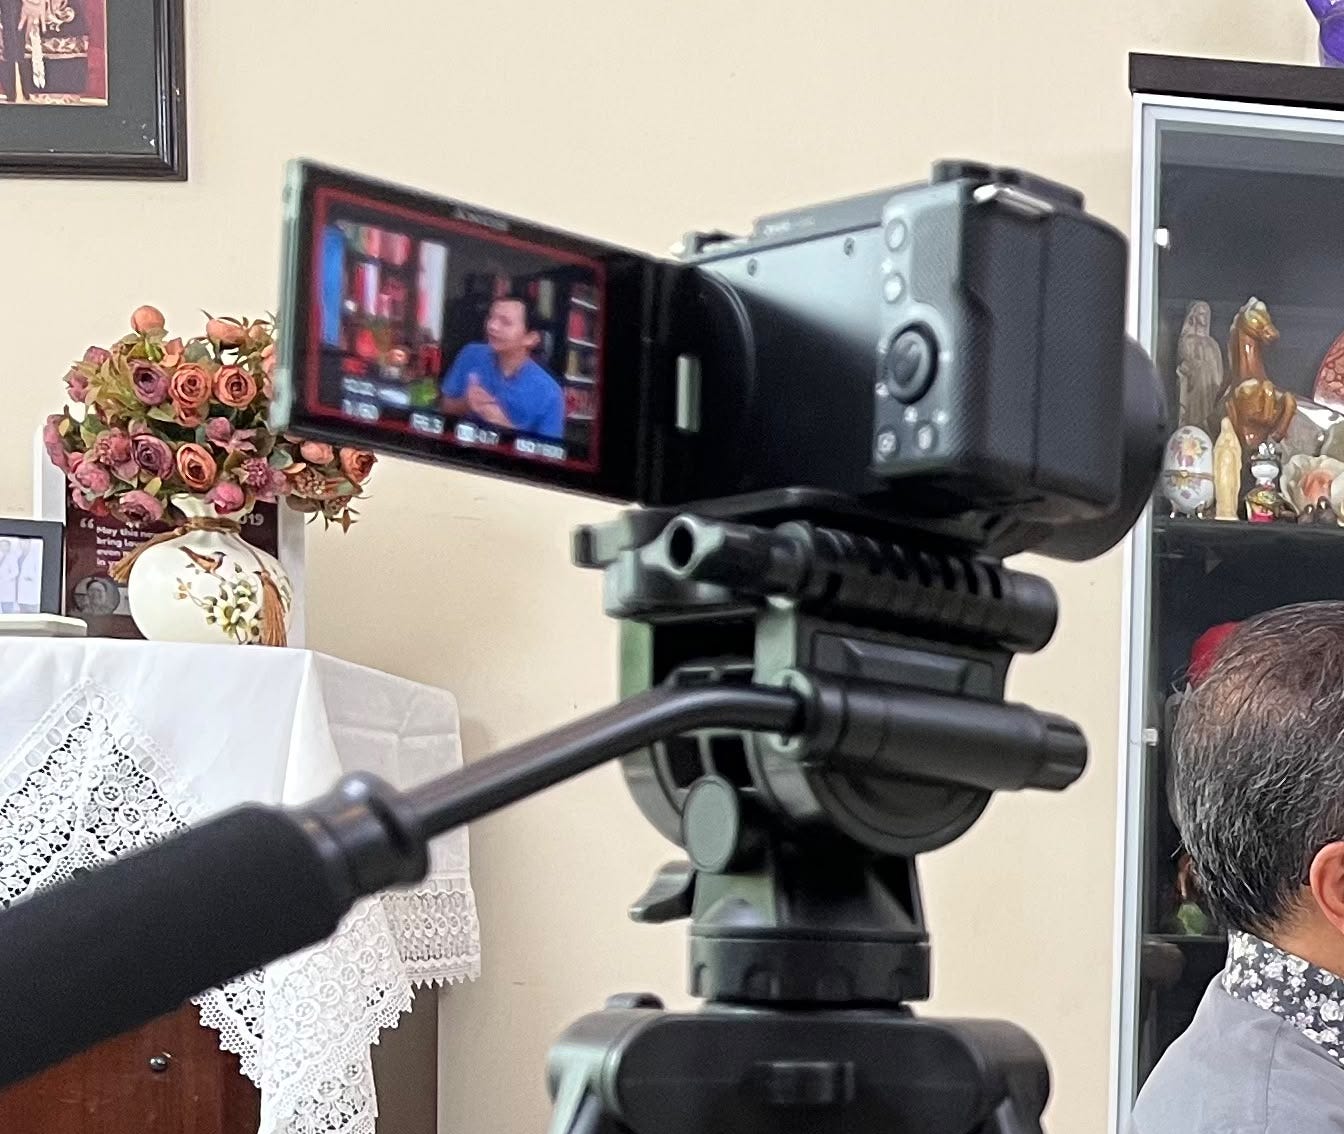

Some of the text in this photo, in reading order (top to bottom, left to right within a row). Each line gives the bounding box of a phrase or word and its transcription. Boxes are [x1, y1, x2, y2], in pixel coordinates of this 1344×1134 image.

[96, 526, 139, 537] May this
[96, 537, 122, 547] bring
[96, 549, 121, 557] even
